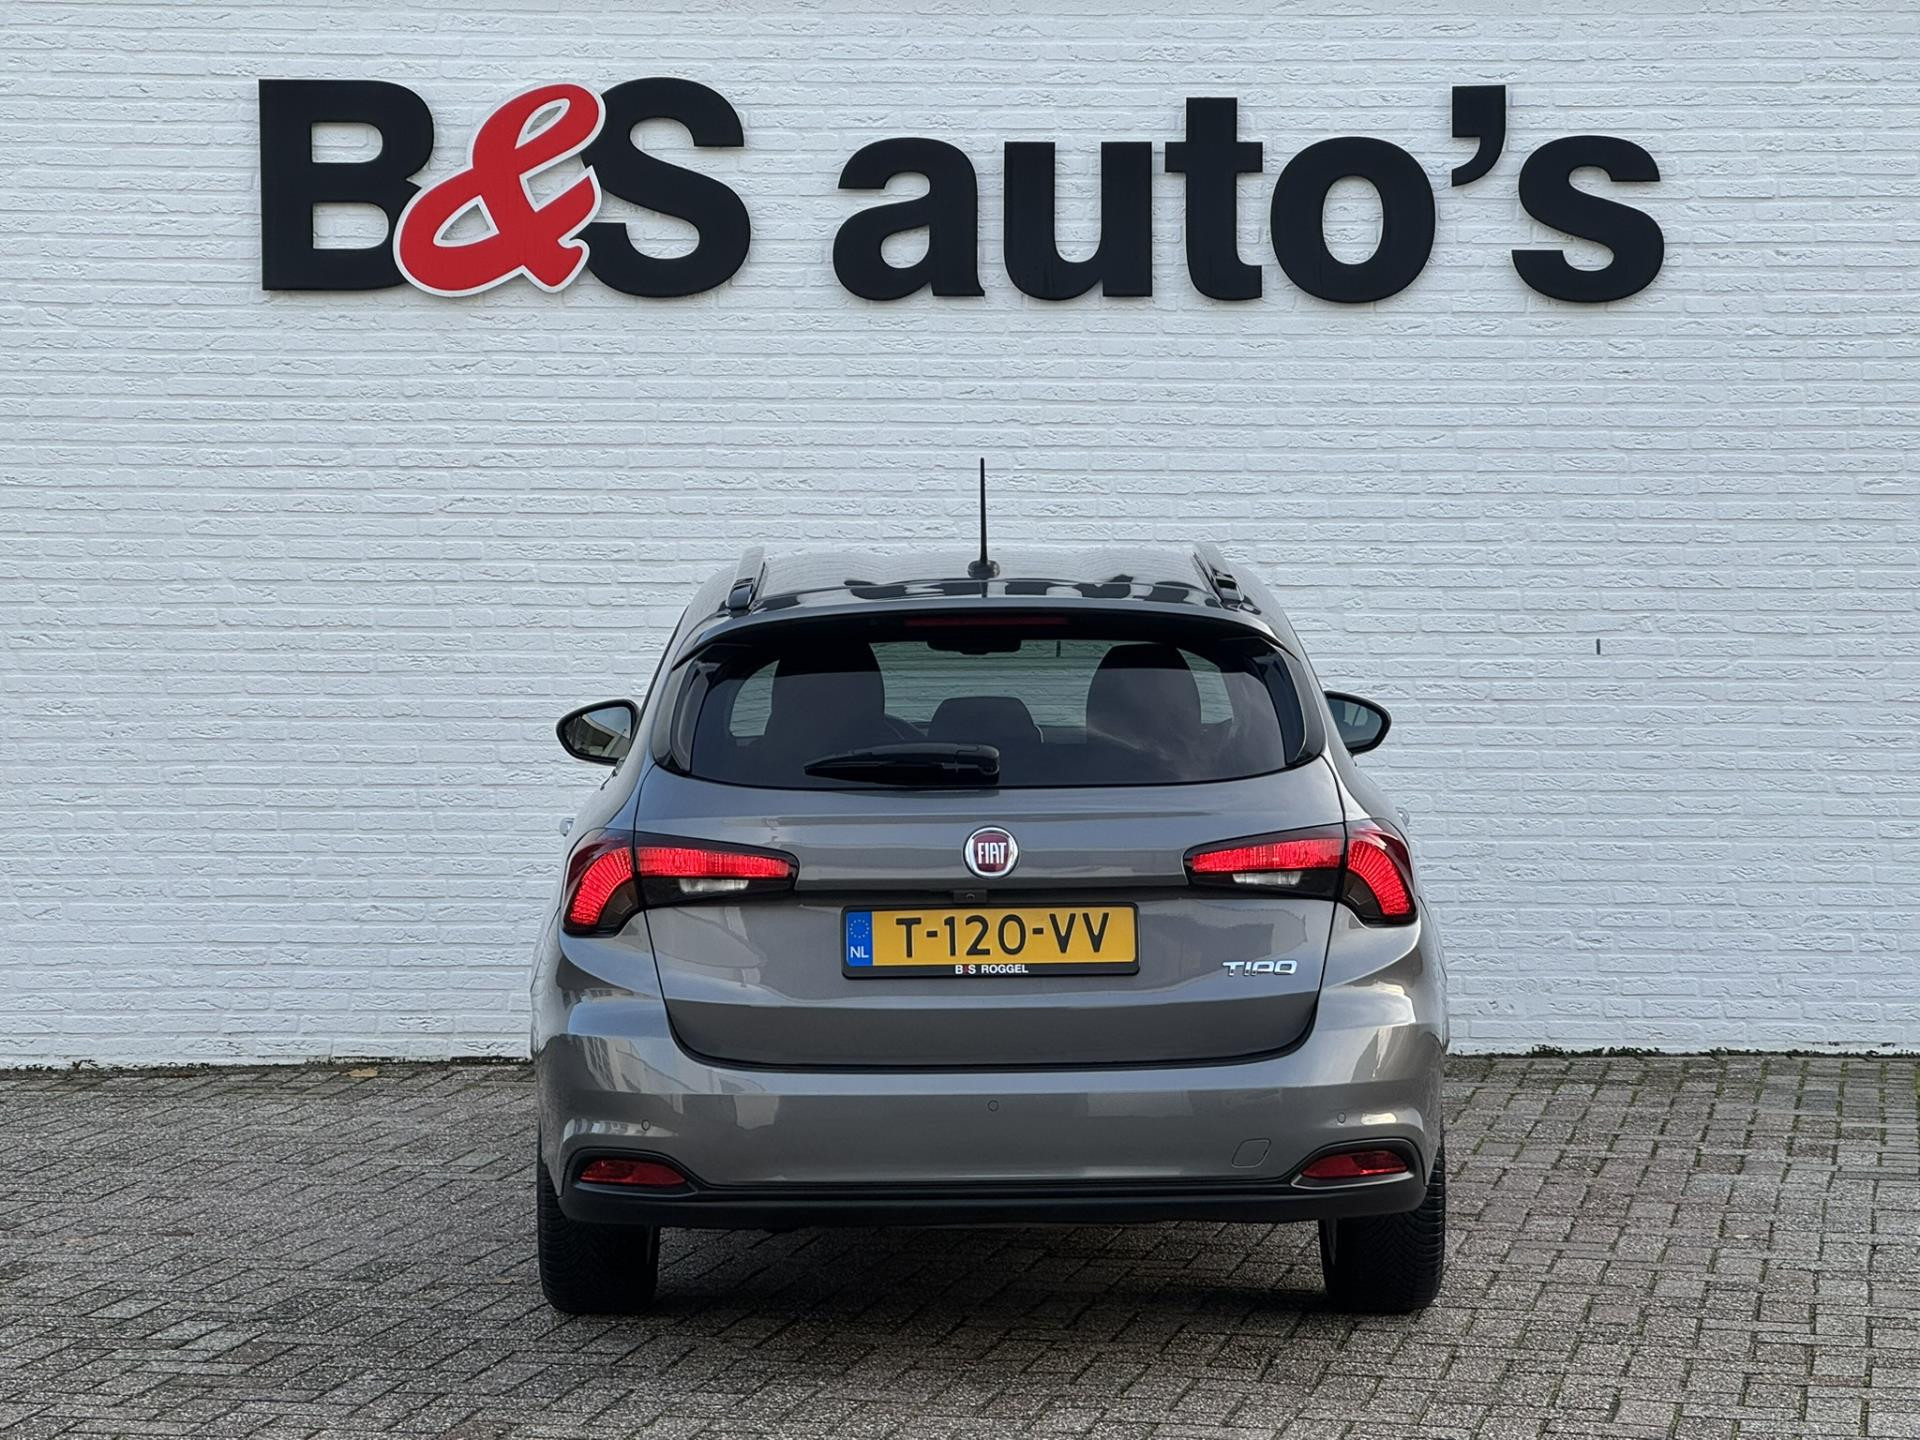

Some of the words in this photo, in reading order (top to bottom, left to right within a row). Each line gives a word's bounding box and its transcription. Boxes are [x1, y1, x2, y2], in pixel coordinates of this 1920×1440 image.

[259, 77, 751, 298] B&S
[833, 85, 1665, 303] auto's
[977, 842, 1007, 865] FIAT
[896, 913, 1110, 957] T-120-VV
[850, 945, 869, 959] NL
[981, 964, 1029, 974] ROGGEL
[1222, 959, 1298, 977] TIPO
